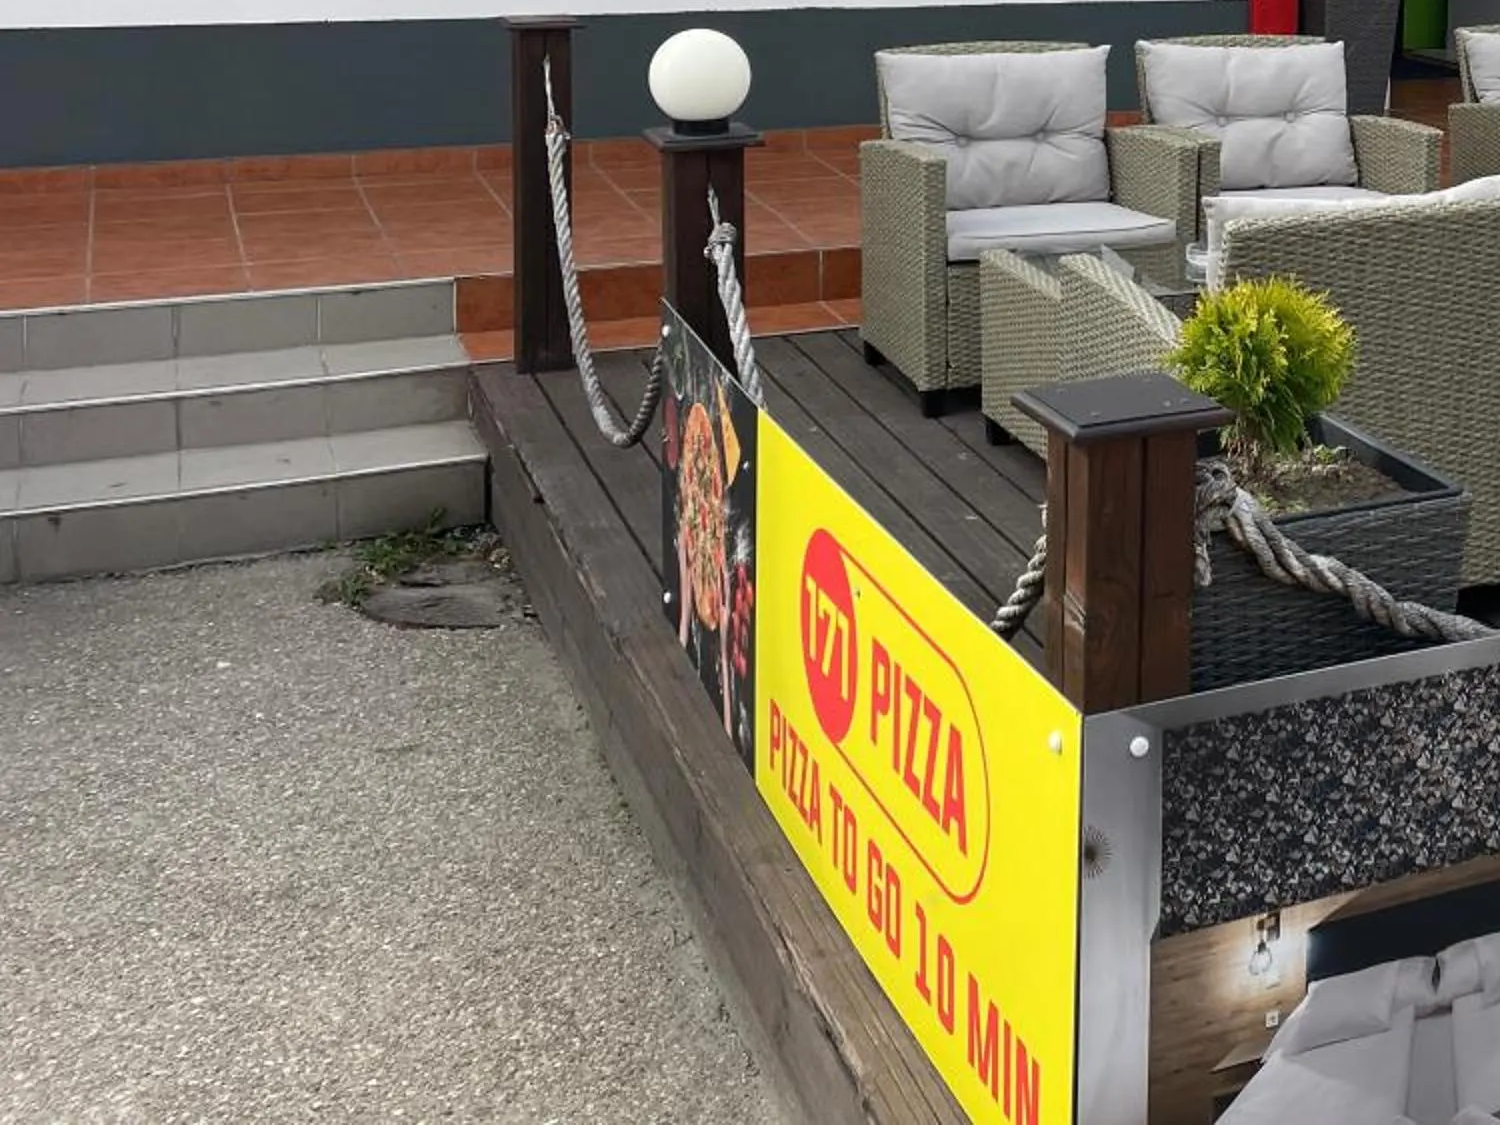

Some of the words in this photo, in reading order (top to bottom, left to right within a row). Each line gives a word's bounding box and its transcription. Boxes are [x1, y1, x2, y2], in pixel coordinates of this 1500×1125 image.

[805, 572, 850, 702] 171
[870, 636, 968, 858] PIZZA
[769, 698, 822, 846] PIZZA
[829, 781, 858, 896] TO
[867, 838, 902, 959] GO
[915, 900, 956, 1036] 10
[967, 971, 1041, 1125] MIN
